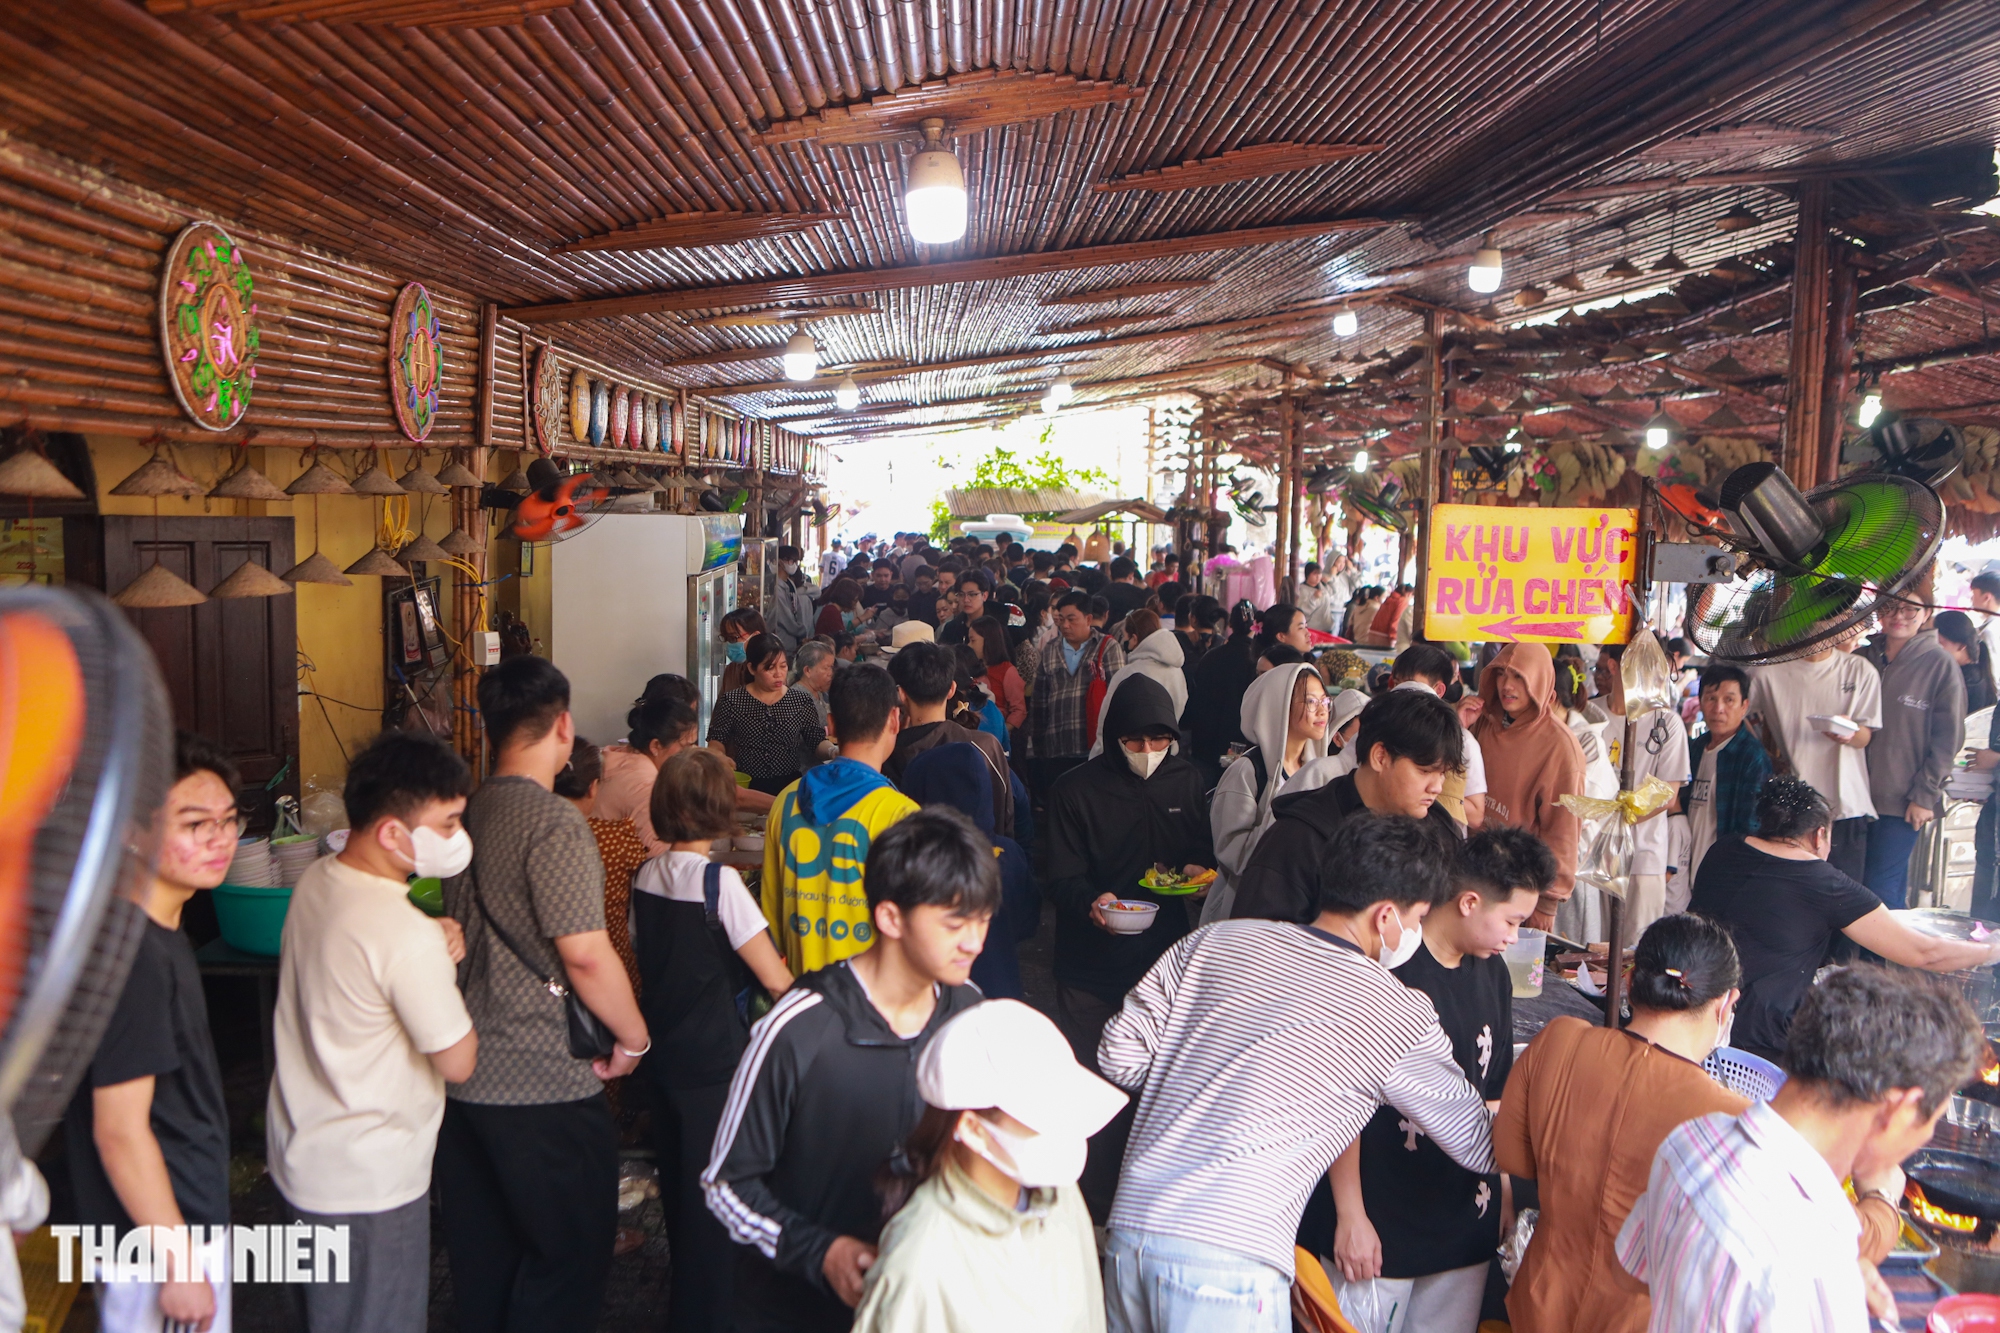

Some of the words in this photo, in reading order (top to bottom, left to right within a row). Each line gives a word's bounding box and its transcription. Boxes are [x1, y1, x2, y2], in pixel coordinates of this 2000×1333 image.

[829, 561, 837, 575] 6
[1444, 524, 1529, 563] KHU
[1550, 513, 1630, 574] VỰC
[1436, 562, 1515, 615] RỬA
[1523, 564, 1629, 615] CHÉN
